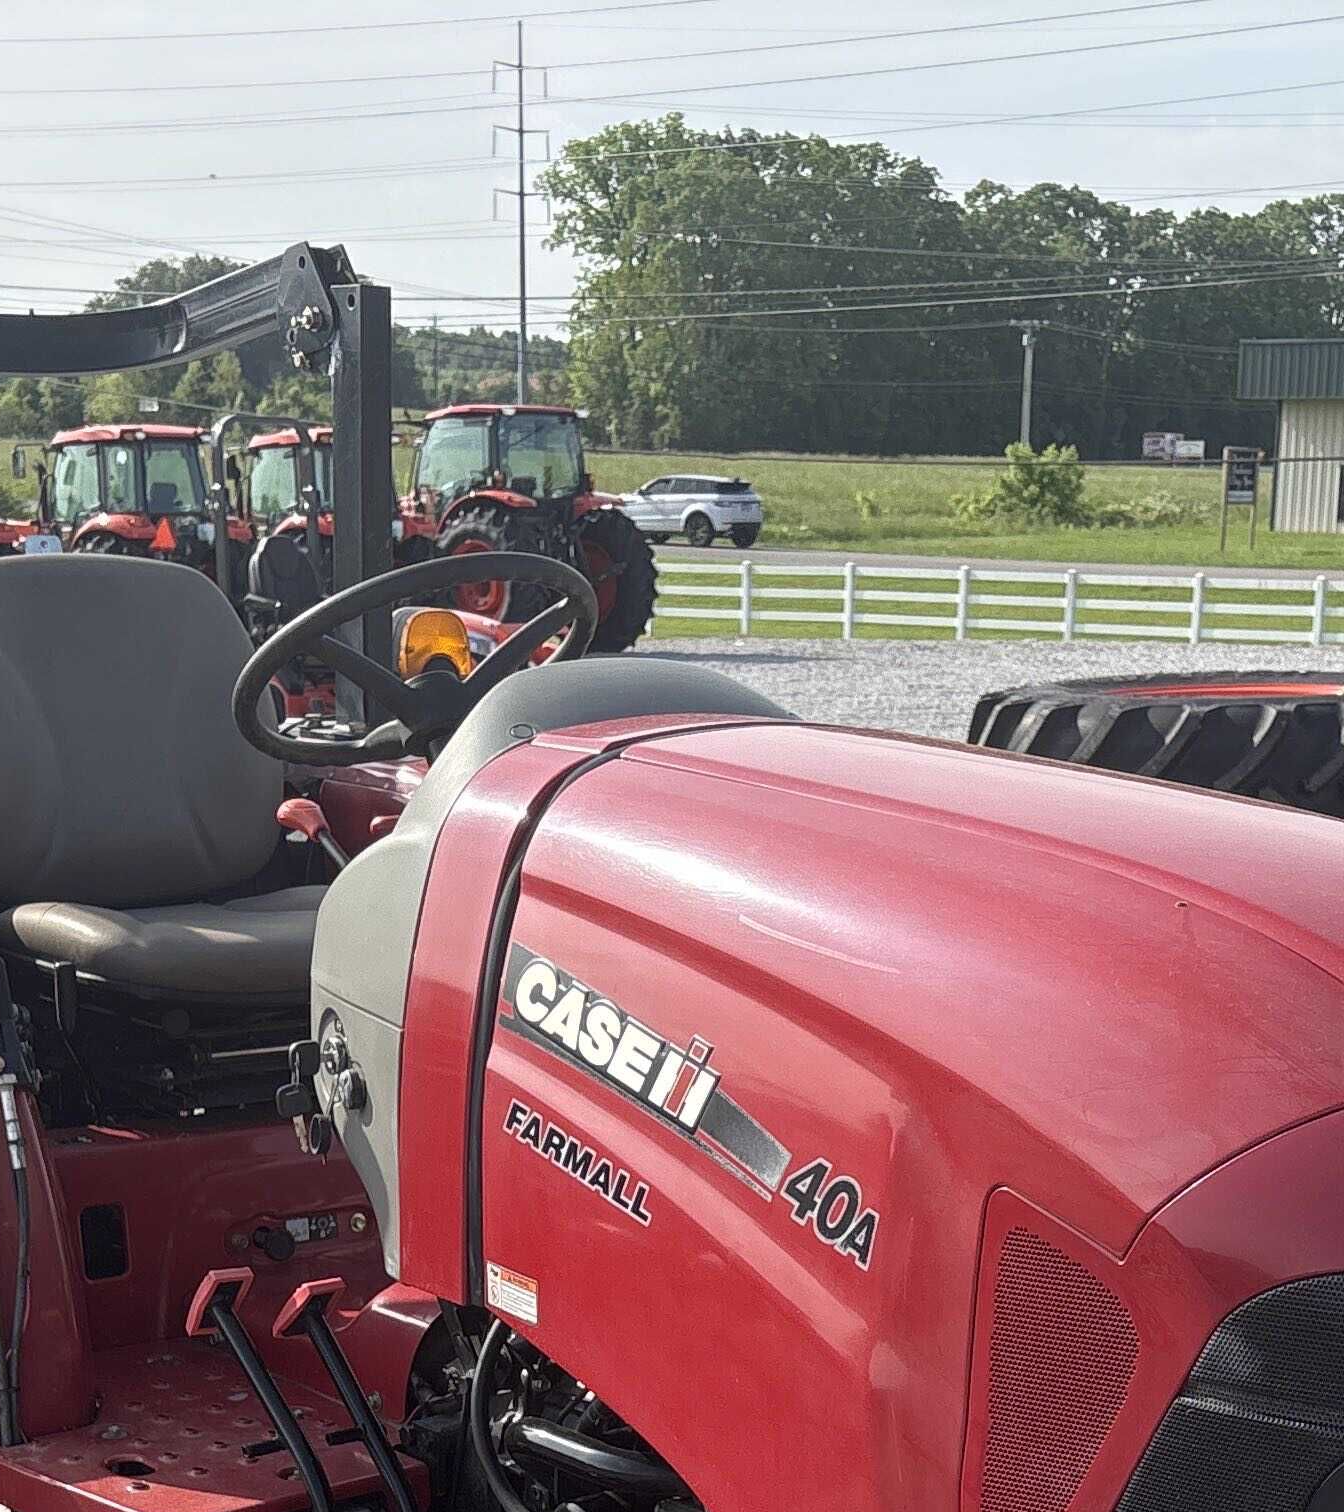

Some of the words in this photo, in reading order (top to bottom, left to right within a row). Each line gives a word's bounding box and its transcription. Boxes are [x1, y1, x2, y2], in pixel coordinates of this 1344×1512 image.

[515, 959, 667, 1094] CASE
[503, 1100, 655, 1227] FARMALL
[782, 1157, 881, 1271] 40A
